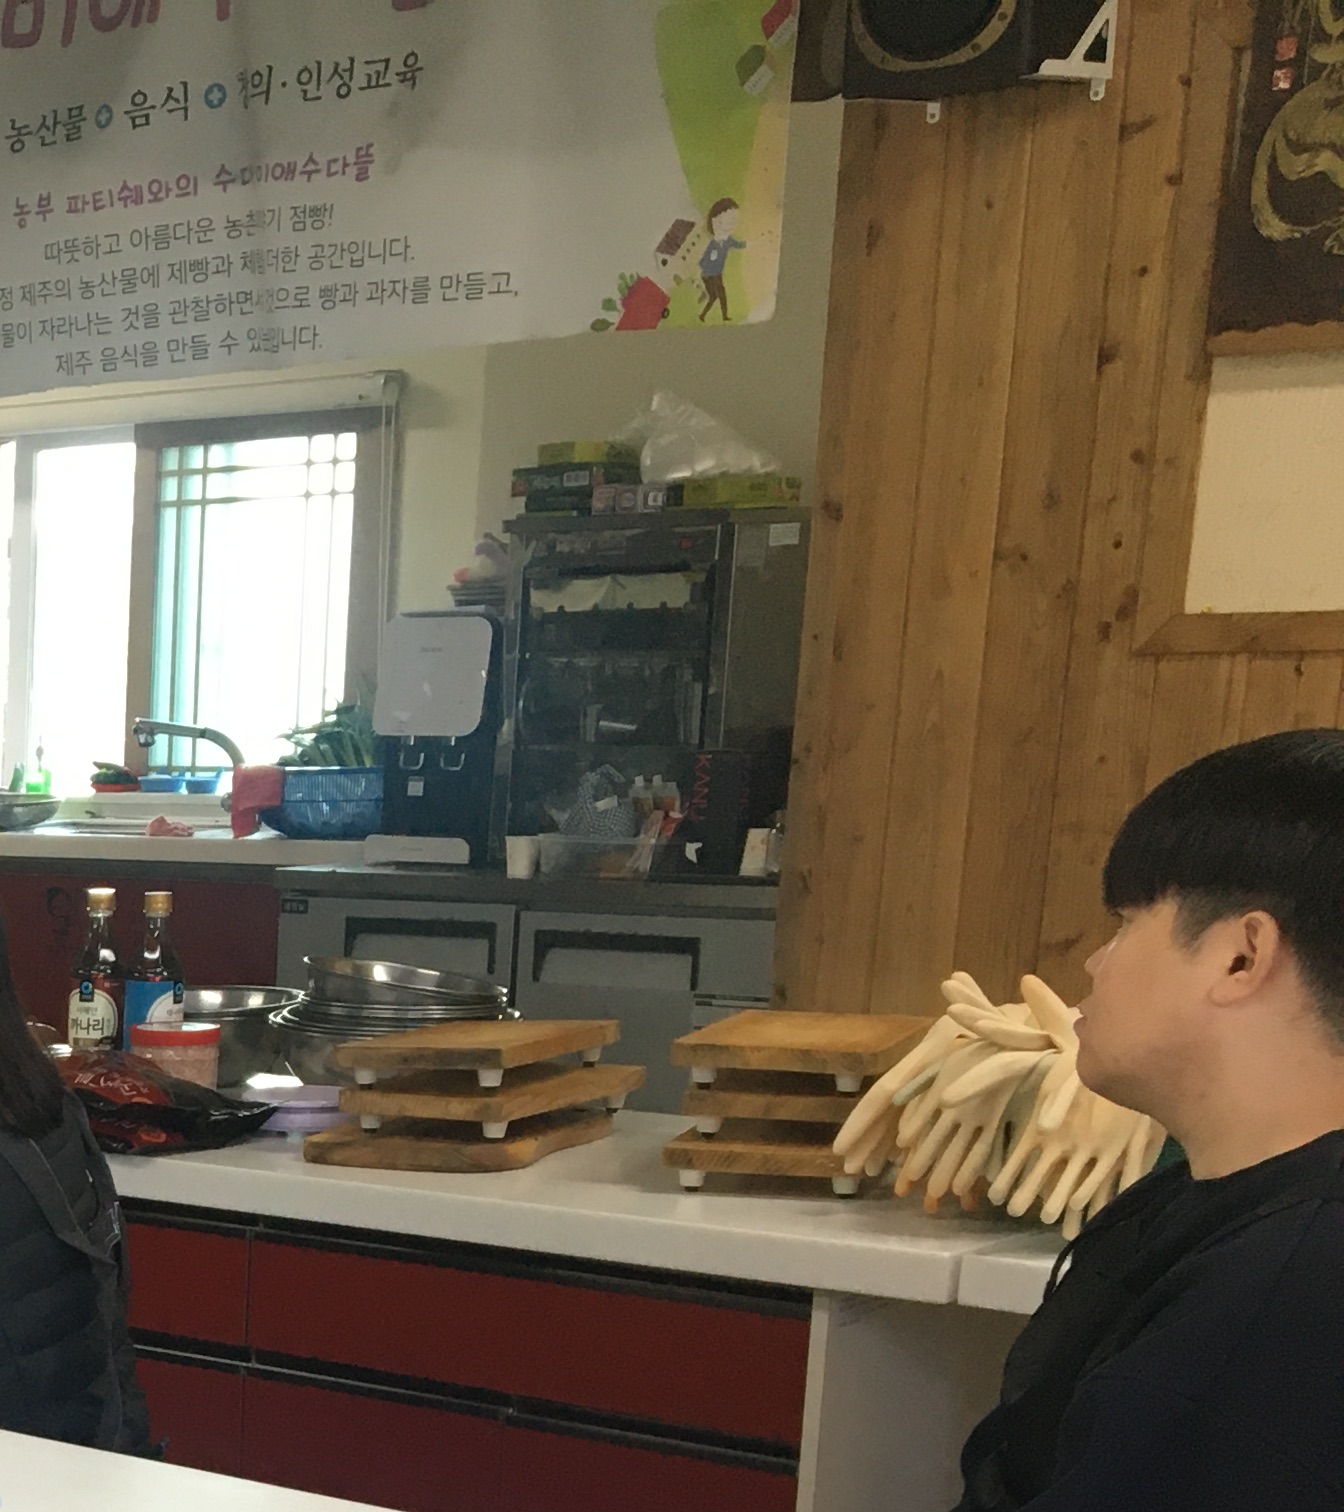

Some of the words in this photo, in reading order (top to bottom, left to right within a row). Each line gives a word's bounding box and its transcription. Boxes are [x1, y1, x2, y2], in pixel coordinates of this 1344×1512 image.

[4, 104, 87, 154] 농산물
[123, 81, 190, 130] 음식
[12, 192, 55, 228] 농부
[65, 173, 199, 214] 파티쉐와의
[20, 276, 72, 307] 제주의
[78, 263, 160, 301] 농산물에
[167, 252, 233, 286] 제빵과
[307, 236, 415, 270] 공간입니다.
[44, 233, 123, 265] 따뜻하고
[129, 217, 216, 252] 아름다운
[38, 310, 113, 341] 자라나는
[120, 302, 161, 332] 것을
[318, 281, 359, 311] 빵과
[366, 275, 432, 304] 과자를
[439, 271, 518, 302] 만들고,
[55, 352, 94, 377] 제주
[99, 341, 161, 373] 음식을
[167, 333, 211, 362] 만들
[218, 330, 241, 356] 수
